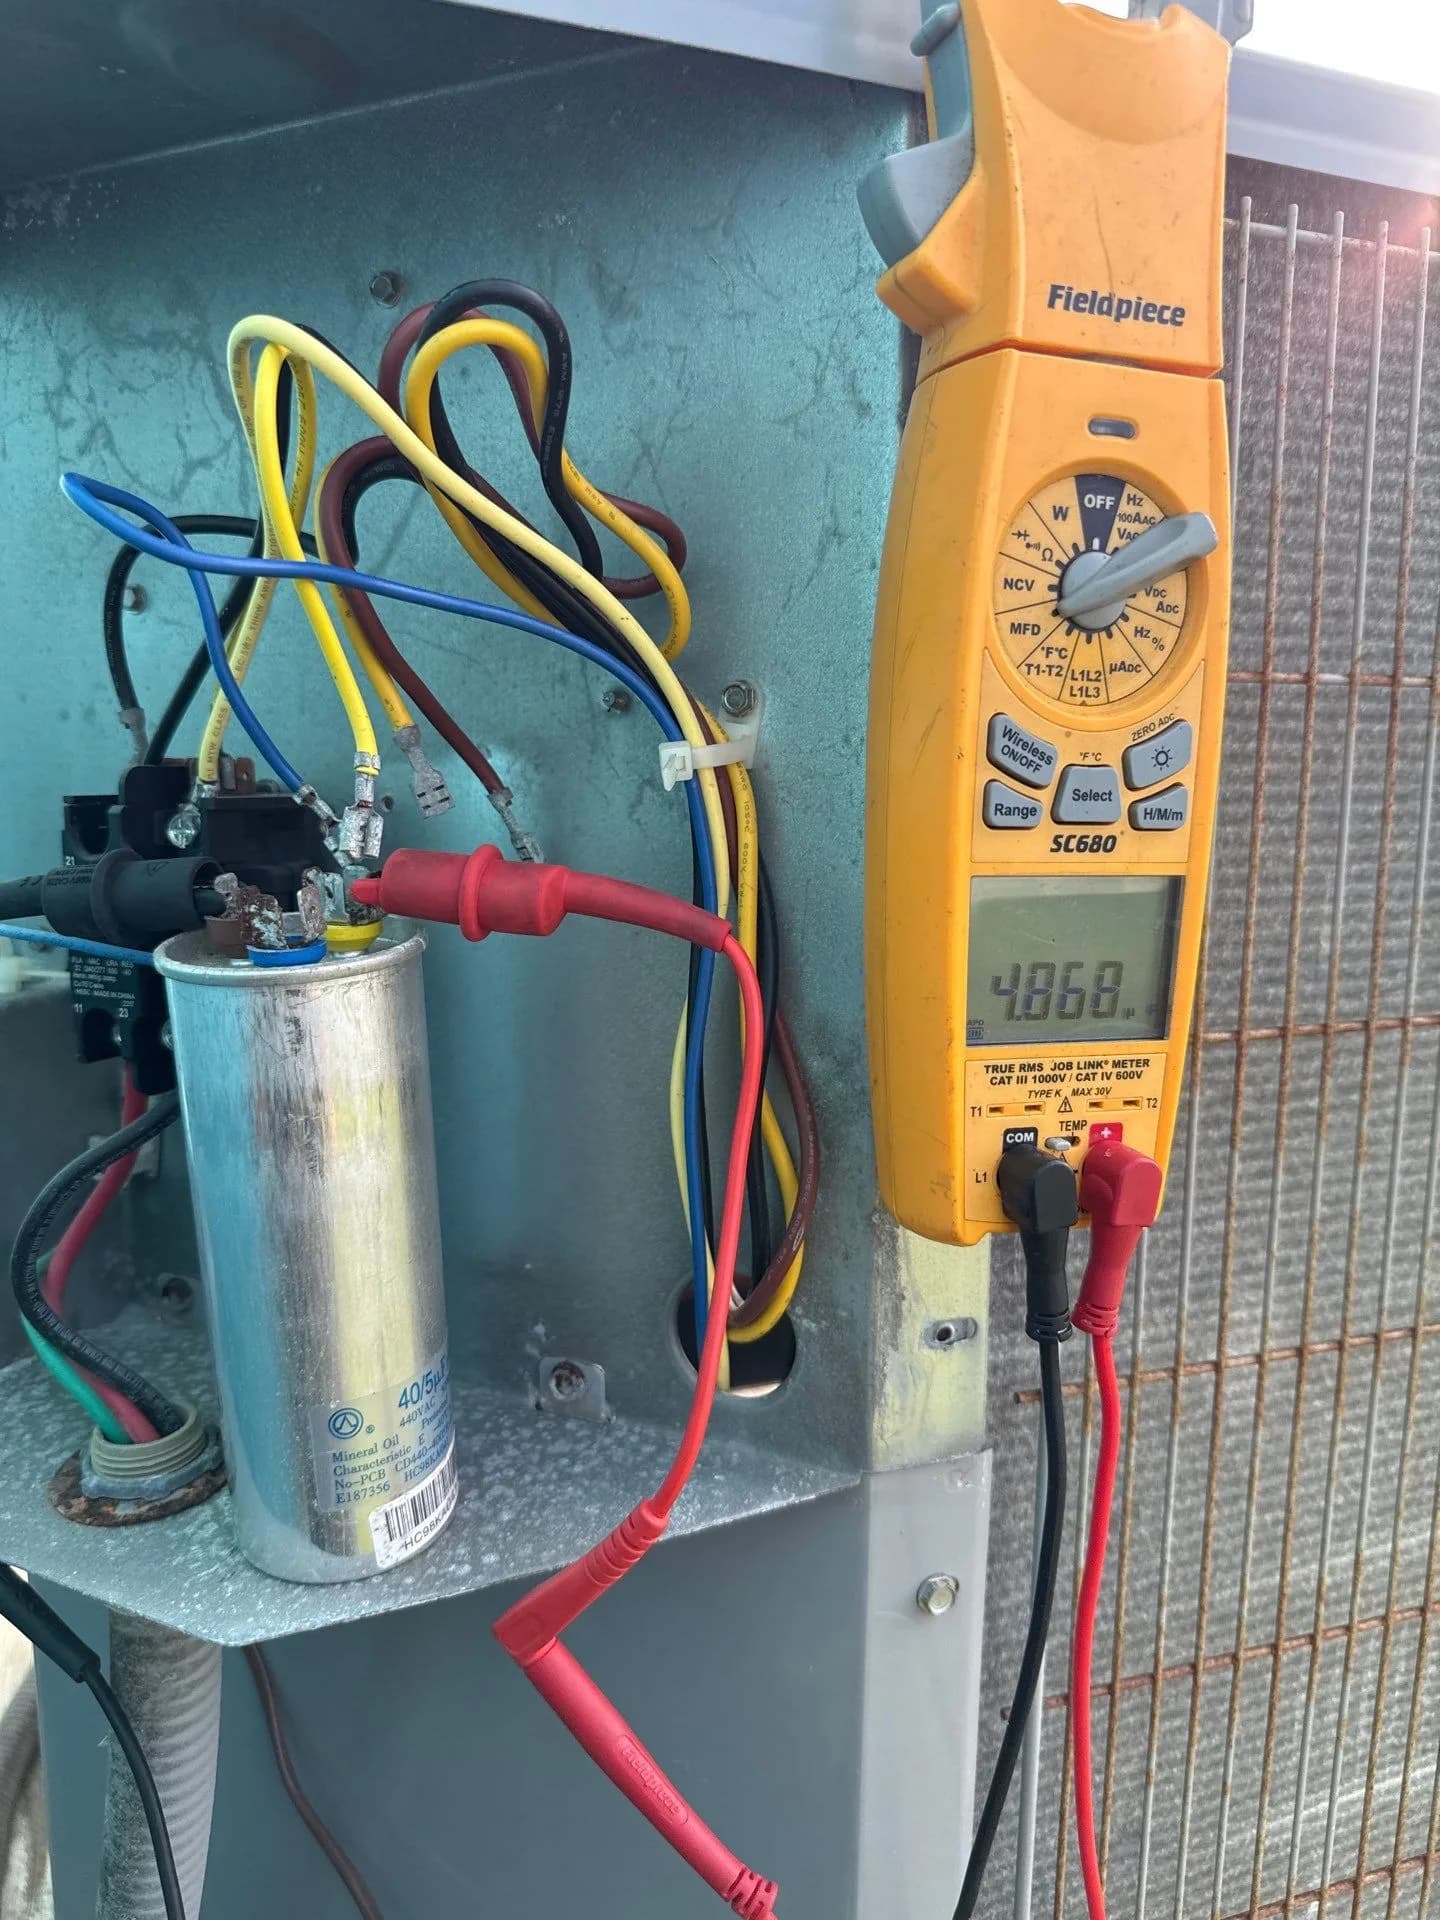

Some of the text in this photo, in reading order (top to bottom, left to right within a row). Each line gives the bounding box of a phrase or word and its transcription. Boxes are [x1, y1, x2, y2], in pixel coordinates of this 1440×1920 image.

[1047, 284, 1186, 327] Fieldpiece
[1084, 494, 1115, 510] OFF
[1126, 493, 1144, 507] Hz
[1053, 506, 1069, 522] W
[1003, 577, 1035, 592] NCV
[1009, 622, 1041, 636] MFD
[1134, 626, 1165, 651] Hz %
[1024, 663, 1064, 677] T1-T2
[1070, 669, 1102, 683] L1L2
[1069, 686, 1101, 699] L1L3
[1131, 721, 1156, 743] ZERO
[1001, 725, 1054, 766] Wireless
[1001, 744, 1043, 775] ON/OFF
[1072, 789, 1113, 802] Select
[994, 803, 1037, 819] Range
[1143, 808, 1183, 821] H/M/m
[1050, 834, 1117, 853] SC680
[65, 856, 75, 865] 21
[990, 961, 1124, 1021] 4.868
[119, 1008, 129, 1018] 23
[984, 1063, 1015, 1074] TRUE
[1019, 1063, 1044, 1073] RMS
[1050, 1061, 1074, 1072] JOB
[1111, 1058, 1150, 1069] METER
[990, 1075, 1013, 1086] CAT
[1016, 1075, 1028, 1084] III
[1032, 1073, 1066, 1084] 1000V
[1075, 1072, 1098, 1082] CAT
[1101, 1071, 1113, 1081] IV
[1115, 1070, 1143, 1080] 600V
[1027, 1086, 1112, 1098] TYPE K MAX 30V
[1146, 1097, 1158, 1108] T2
[970, 1106, 982, 1117] T1
[1059, 1119, 1088, 1132] TEMP
[1006, 1132, 1034, 1143] COM
[975, 1172, 987, 1183] L1
[400, 1396, 436, 1428] 440VAC
[332, 1434, 399, 1464] Mineral Oil
[333, 1444, 412, 1477] Characteristic
[334, 1469, 387, 1491] No-PCB
[335, 1480, 391, 1504] E187356
